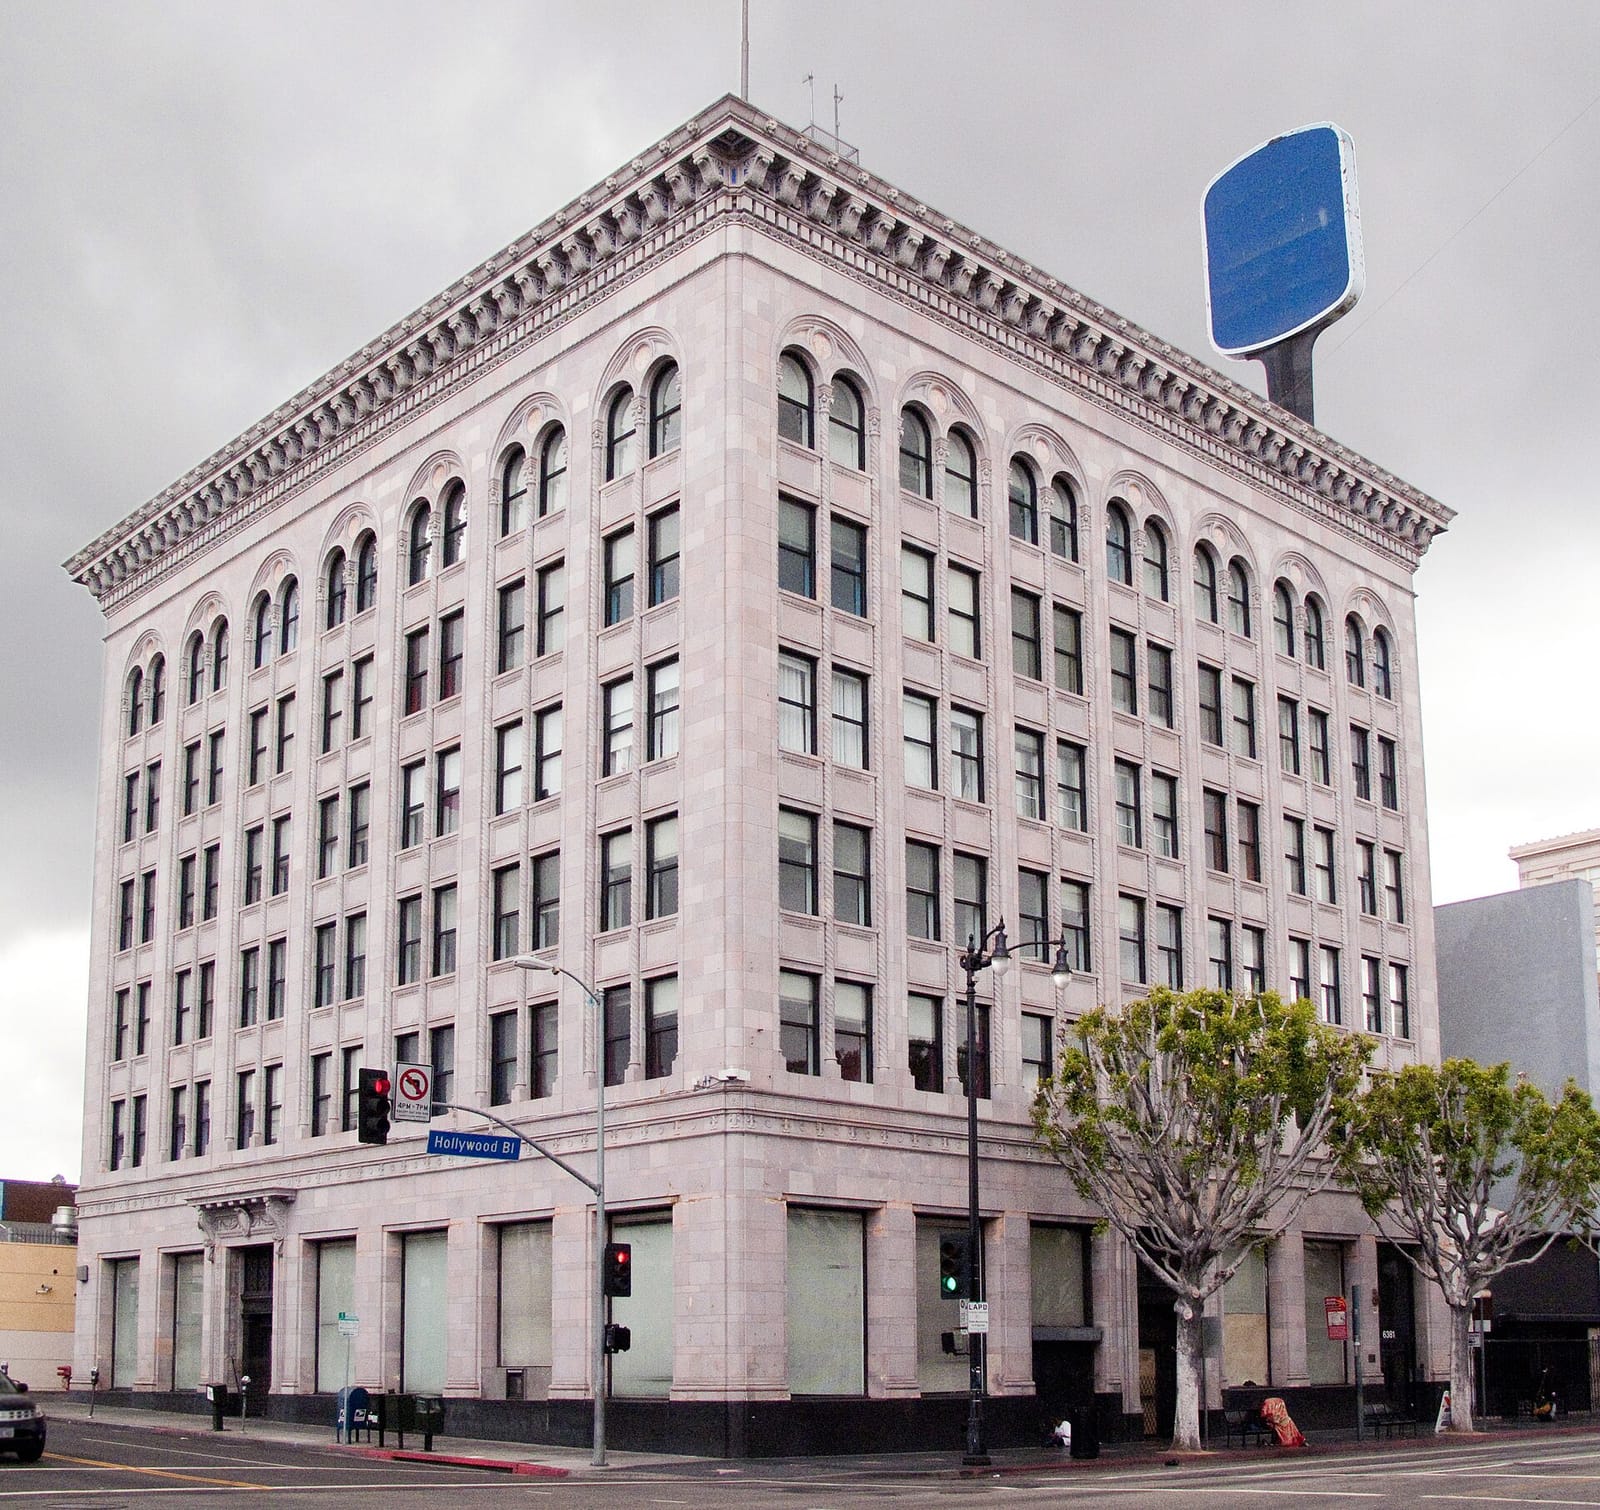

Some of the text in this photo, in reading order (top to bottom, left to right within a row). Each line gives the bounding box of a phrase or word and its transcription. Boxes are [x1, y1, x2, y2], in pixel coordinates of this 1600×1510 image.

[434, 1135, 515, 1154] Hollywood Bl
[1382, 1330, 1395, 1338] 6381
